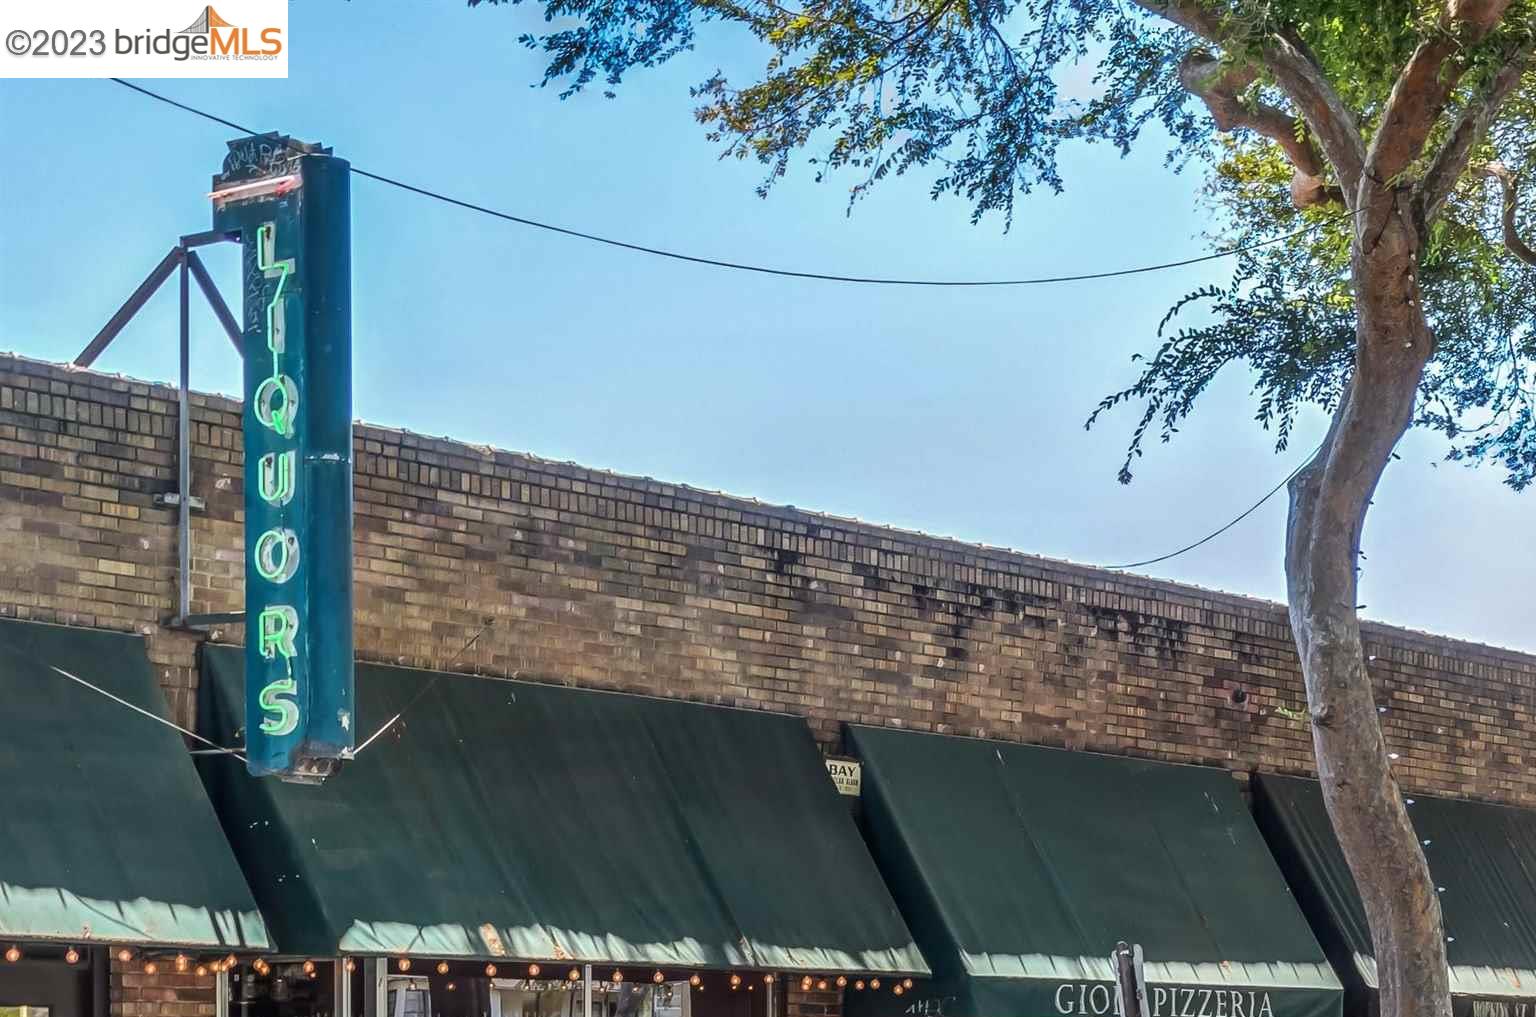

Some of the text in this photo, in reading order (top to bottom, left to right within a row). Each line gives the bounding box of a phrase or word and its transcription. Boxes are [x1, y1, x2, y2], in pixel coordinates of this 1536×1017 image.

[254, 222, 300, 736] LIQUORS
[829, 764, 856, 776] BAY
[1055, 984, 1121, 1015] GIOI
